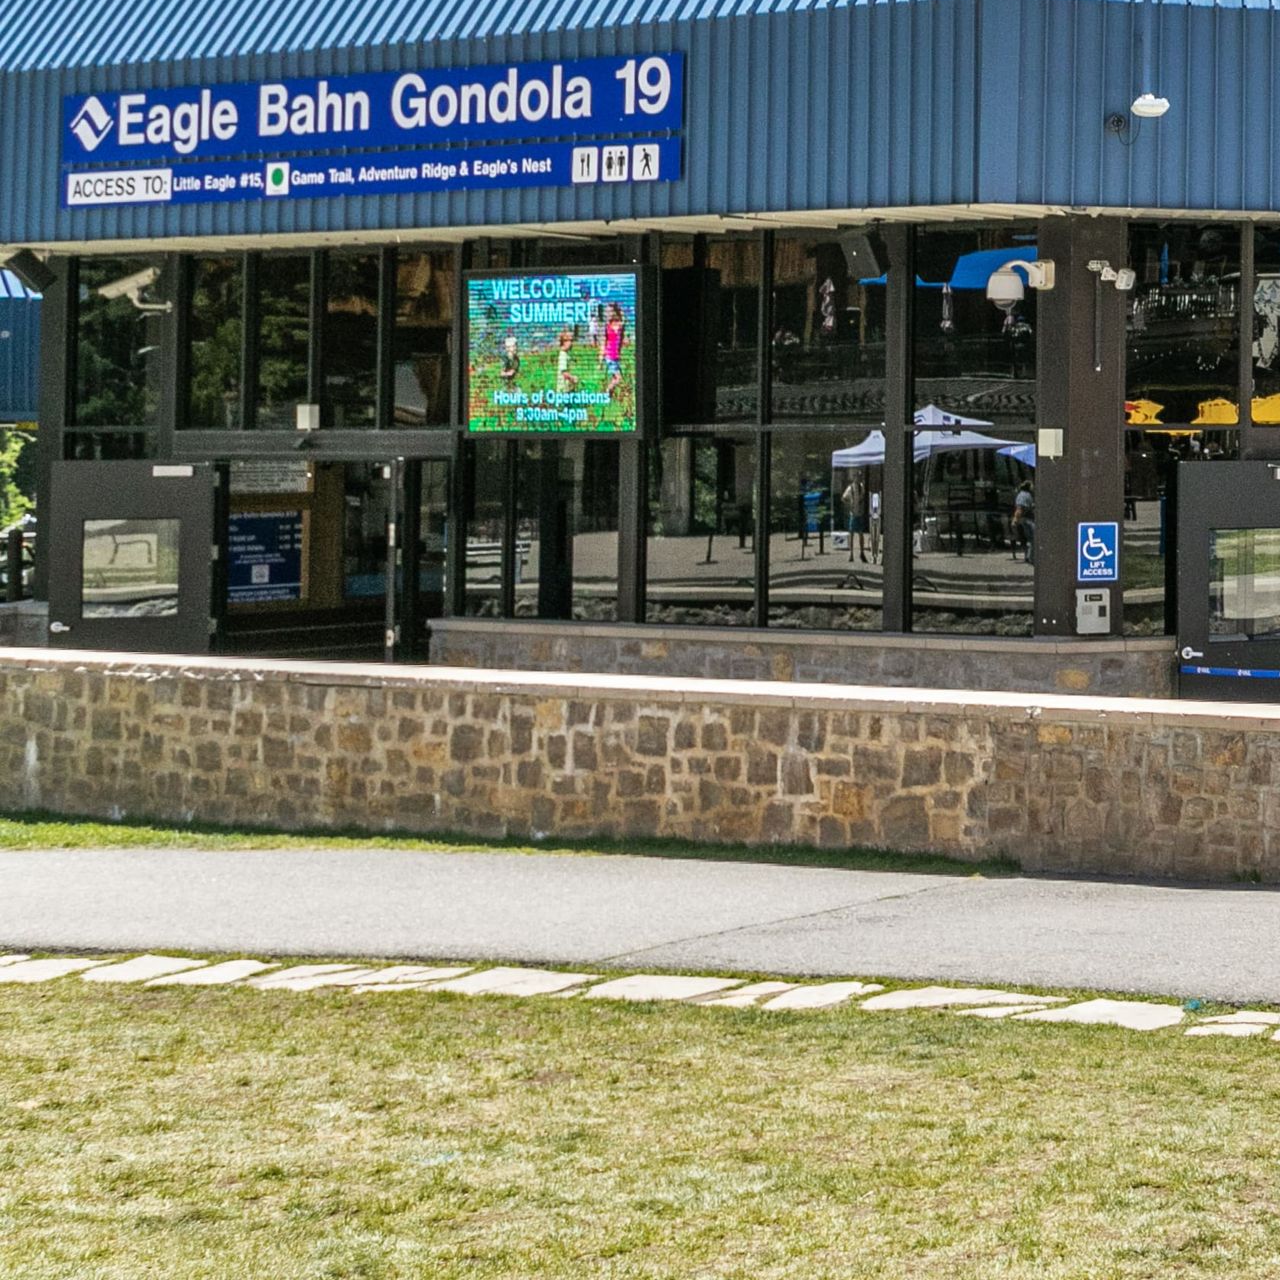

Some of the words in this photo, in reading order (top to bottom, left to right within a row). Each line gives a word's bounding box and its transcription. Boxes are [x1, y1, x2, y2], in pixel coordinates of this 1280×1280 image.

[118, 89, 239, 154] Eagle
[259, 81, 370, 136] Bahn
[391, 64, 592, 129] Gondola
[615, 56, 671, 115] 19
[73, 177, 136, 198] ACCESS
[144, 175, 168, 194] TO:
[173, 176, 201, 191] Little
[204, 174, 236, 192] Eagle
[240, 173, 264, 190] #15,
[291, 171, 324, 186] Game
[329, 168, 355, 185] Trail,
[358, 164, 417, 182] Adventure
[422, 162, 456, 180] Ridge
[459, 161, 469, 176] &
[473, 159, 518, 178] Eagle's
[522, 157, 552, 173] Nest
[492, 278, 582, 300] WELCOME
[588, 279, 611, 297] TO
[494, 390, 528, 404] Hours
[531, 390, 543, 403] of
[546, 390, 611, 407] Operations
[1083, 568, 1113, 576] ACCESS
